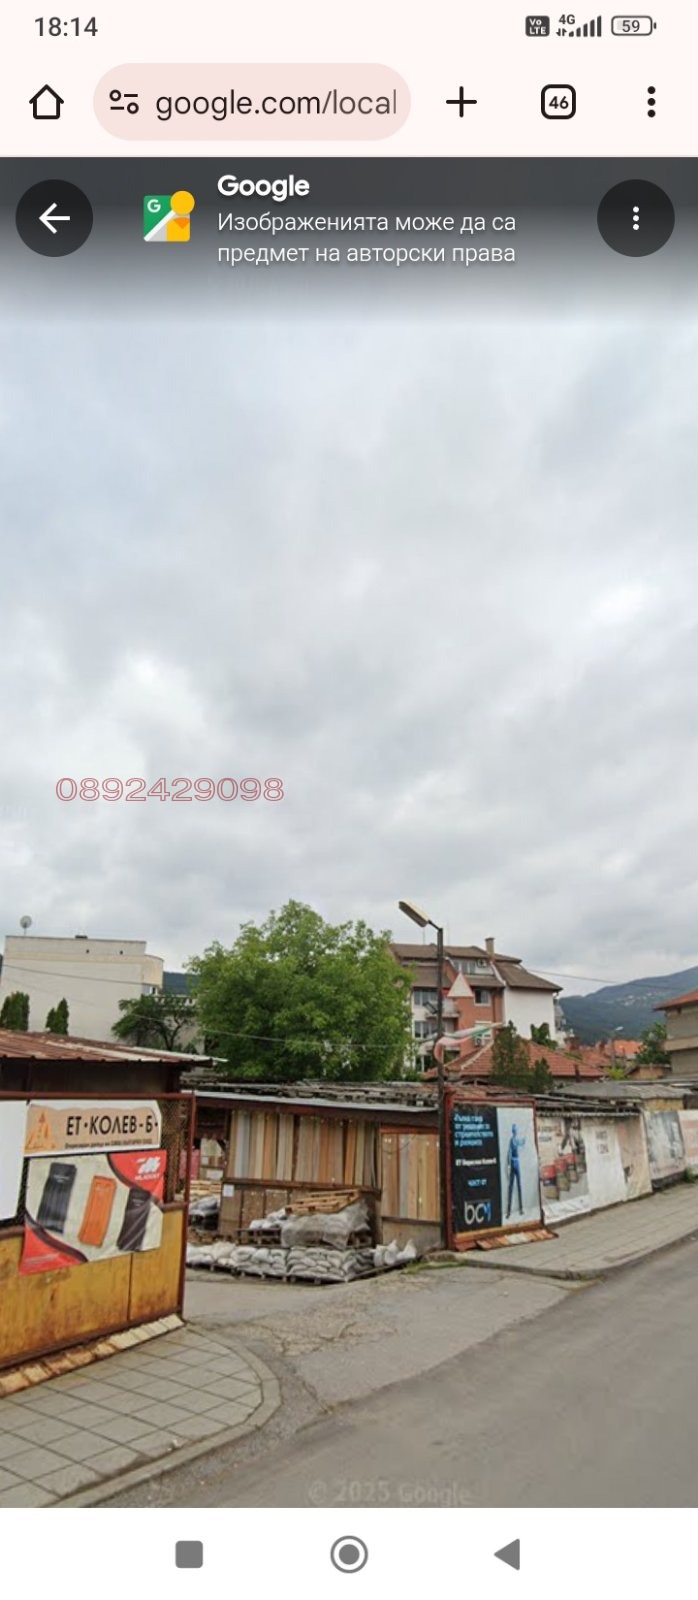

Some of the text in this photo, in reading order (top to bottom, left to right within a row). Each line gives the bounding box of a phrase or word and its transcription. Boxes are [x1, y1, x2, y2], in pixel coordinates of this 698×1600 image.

[34, 17, 98, 37] 18:14
[529, 18, 542, 26] Vo
[558, 14, 576, 25] 4G
[621, 19, 641, 33] 59
[529, 26, 547, 35] LTE
[156, 88, 397, 121] google.com/local
[548, 94, 570, 111] 46
[217, 174, 311, 202] Google
[217, 211, 516, 235] Изображенията може да са
[217, 247, 516, 267] предмет на авторски права
